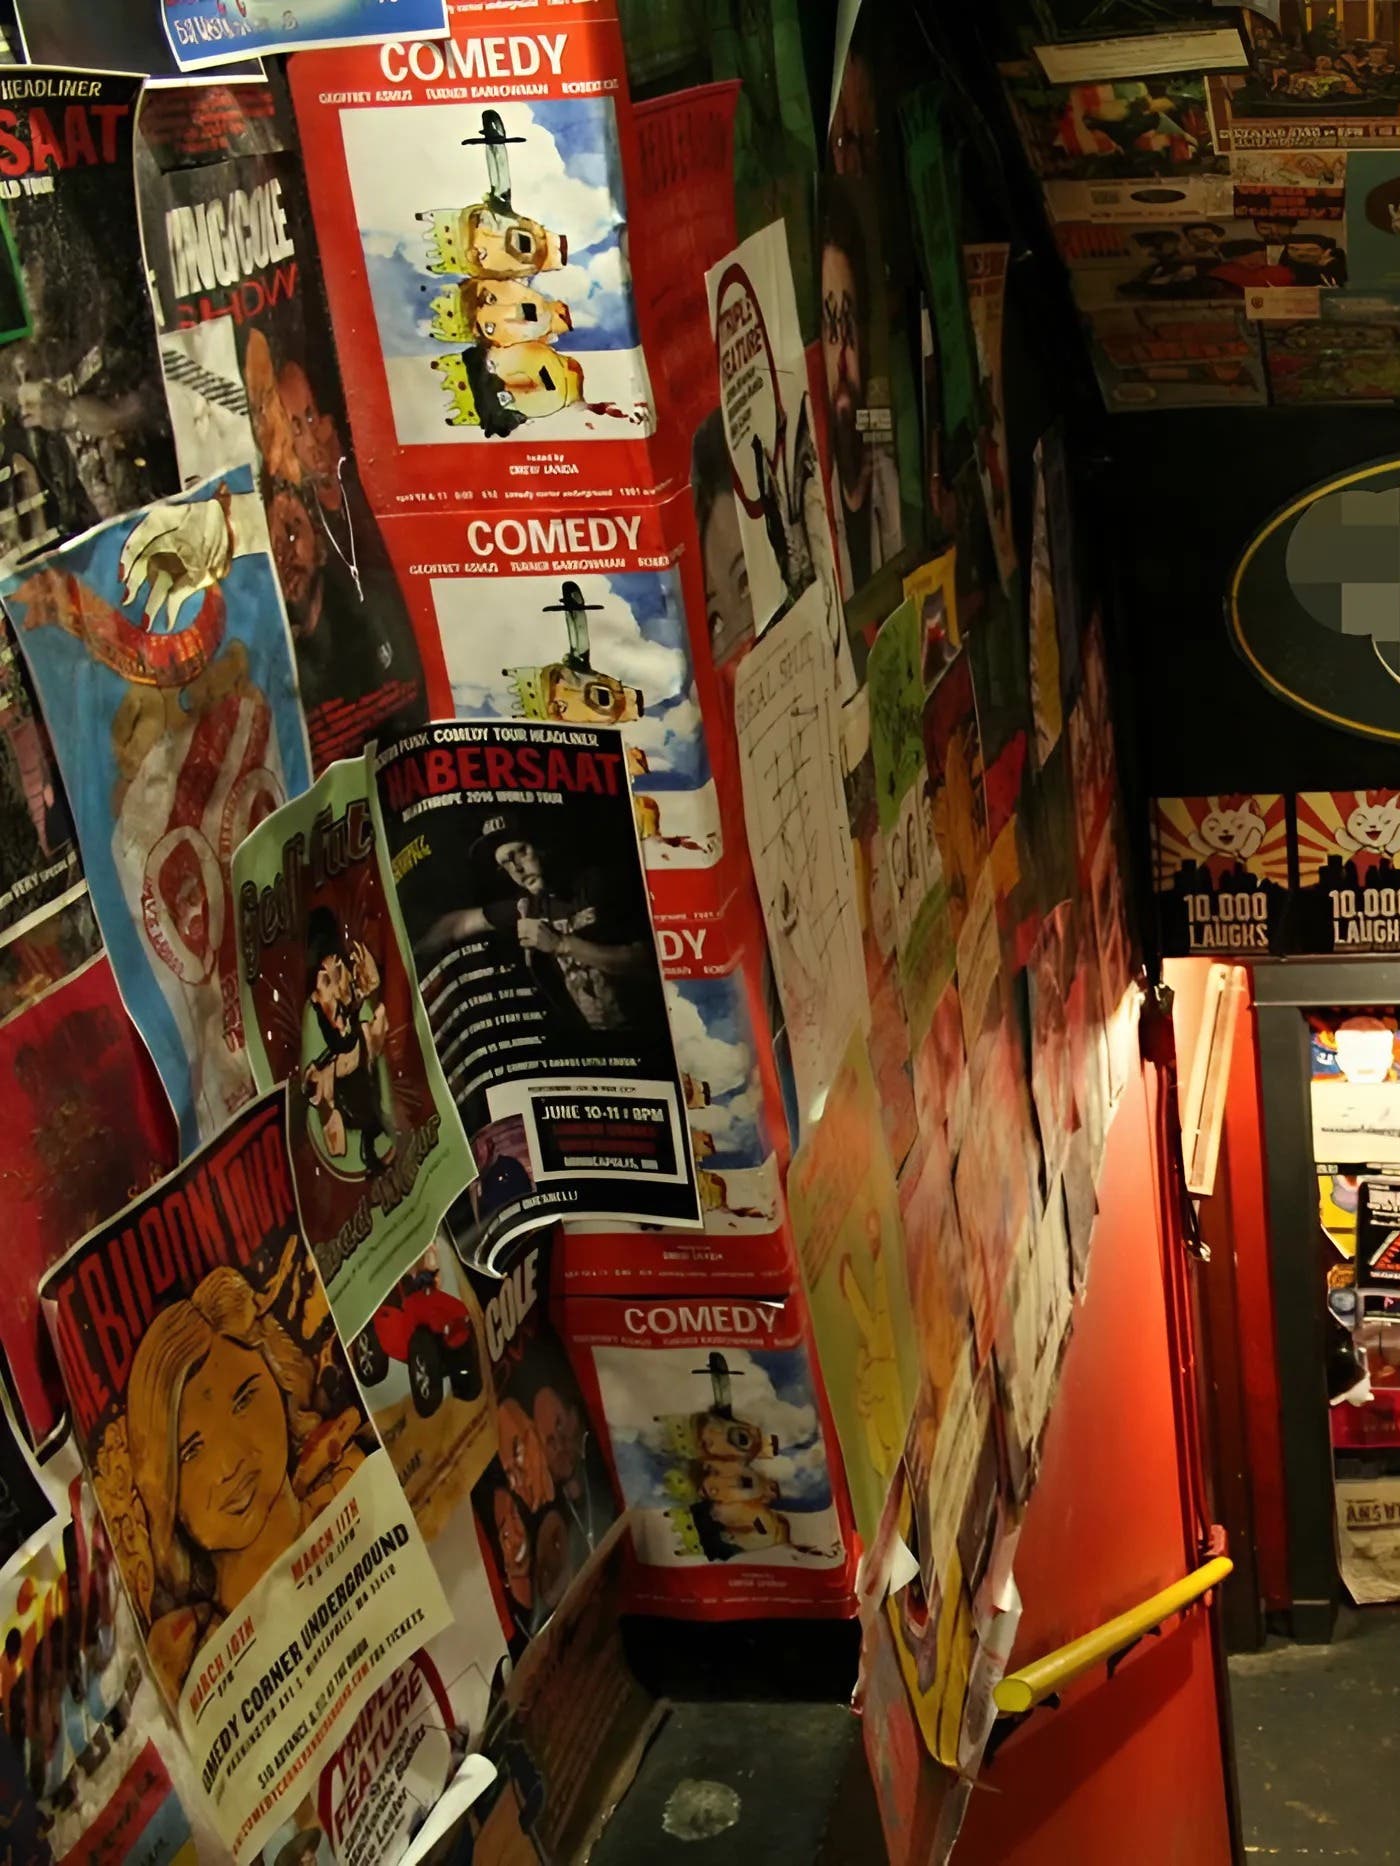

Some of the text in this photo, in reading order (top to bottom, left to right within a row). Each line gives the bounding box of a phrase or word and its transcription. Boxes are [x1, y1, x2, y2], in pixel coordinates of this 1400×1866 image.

[379, 34, 568, 83] COMEDY
[467, 516, 642, 557] COMEDY
[433, 730, 488, 744] COMEDY
[493, 727, 527, 743] TOUR
[384, 747, 622, 814] HABERSAAT
[1183, 891, 1268, 922] 10,000
[1189, 917, 1269, 949] LAUGHS
[541, 1105, 579, 1120] JUNE
[585, 1105, 620, 1118] 10-11
[624, 1306, 777, 1335] COMEDY
[290, 1527, 335, 1585] MARCH
[240, 1640, 304, 1726] CORNER
[300, 1522, 411, 1651] UNDERGROUND
[385, 1607, 426, 1648] TICKETS
[189, 1654, 226, 1715] MARCH
[334, 1665, 424, 1846] FEATURE
